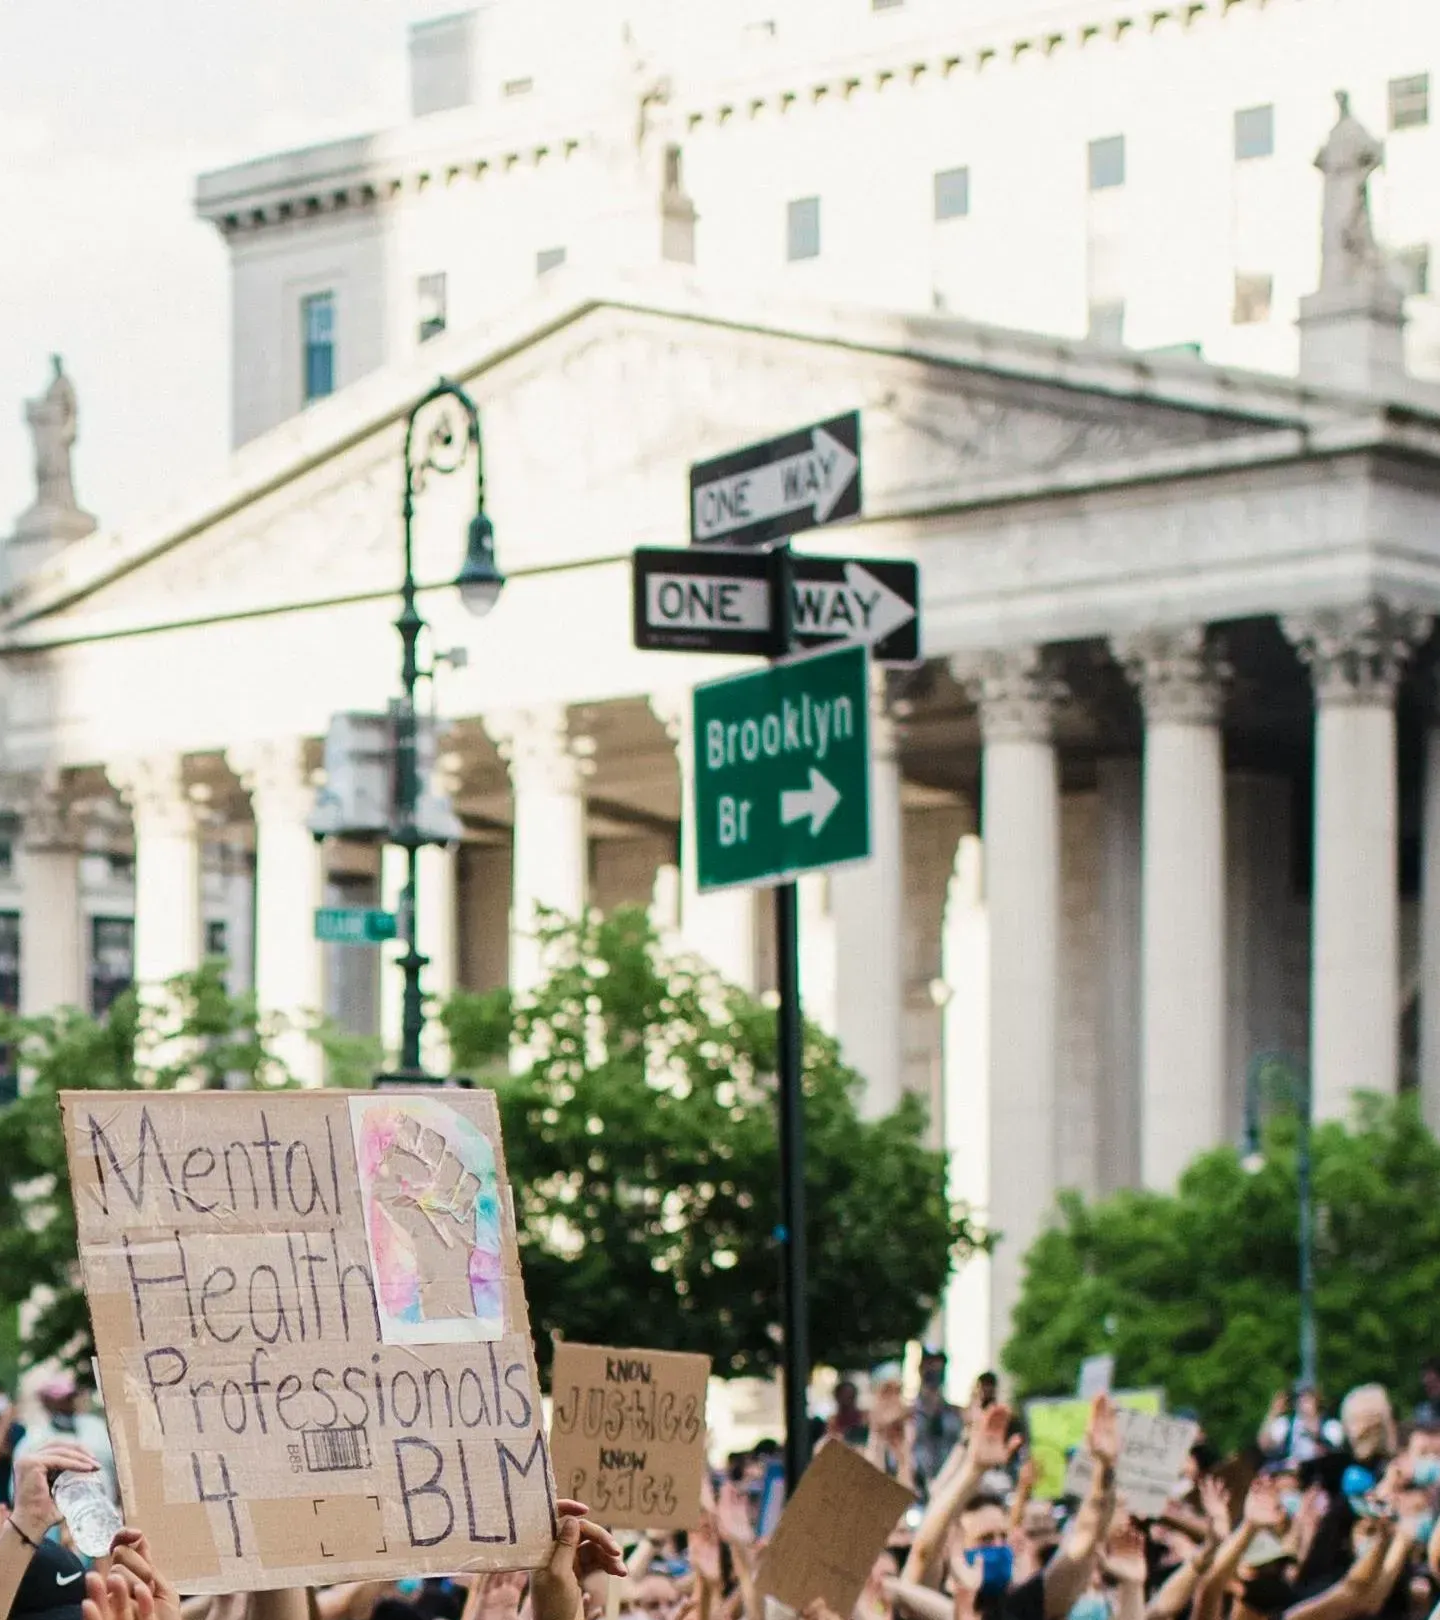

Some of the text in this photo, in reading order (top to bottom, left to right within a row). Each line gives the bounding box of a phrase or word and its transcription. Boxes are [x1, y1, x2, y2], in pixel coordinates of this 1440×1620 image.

[699, 449, 838, 529] ONE WAY
[657, 580, 880, 629] ONE WAY
[706, 693, 854, 770] Brooklyn
[716, 795, 752, 846] Br
[87, 1106, 342, 1216] Mental
[123, 1228, 383, 1344] Health
[144, 1342, 532, 1435] Professionals
[192, 1430, 559, 1557] 4 BLM
[600, 1447, 647, 1471] KNOW
